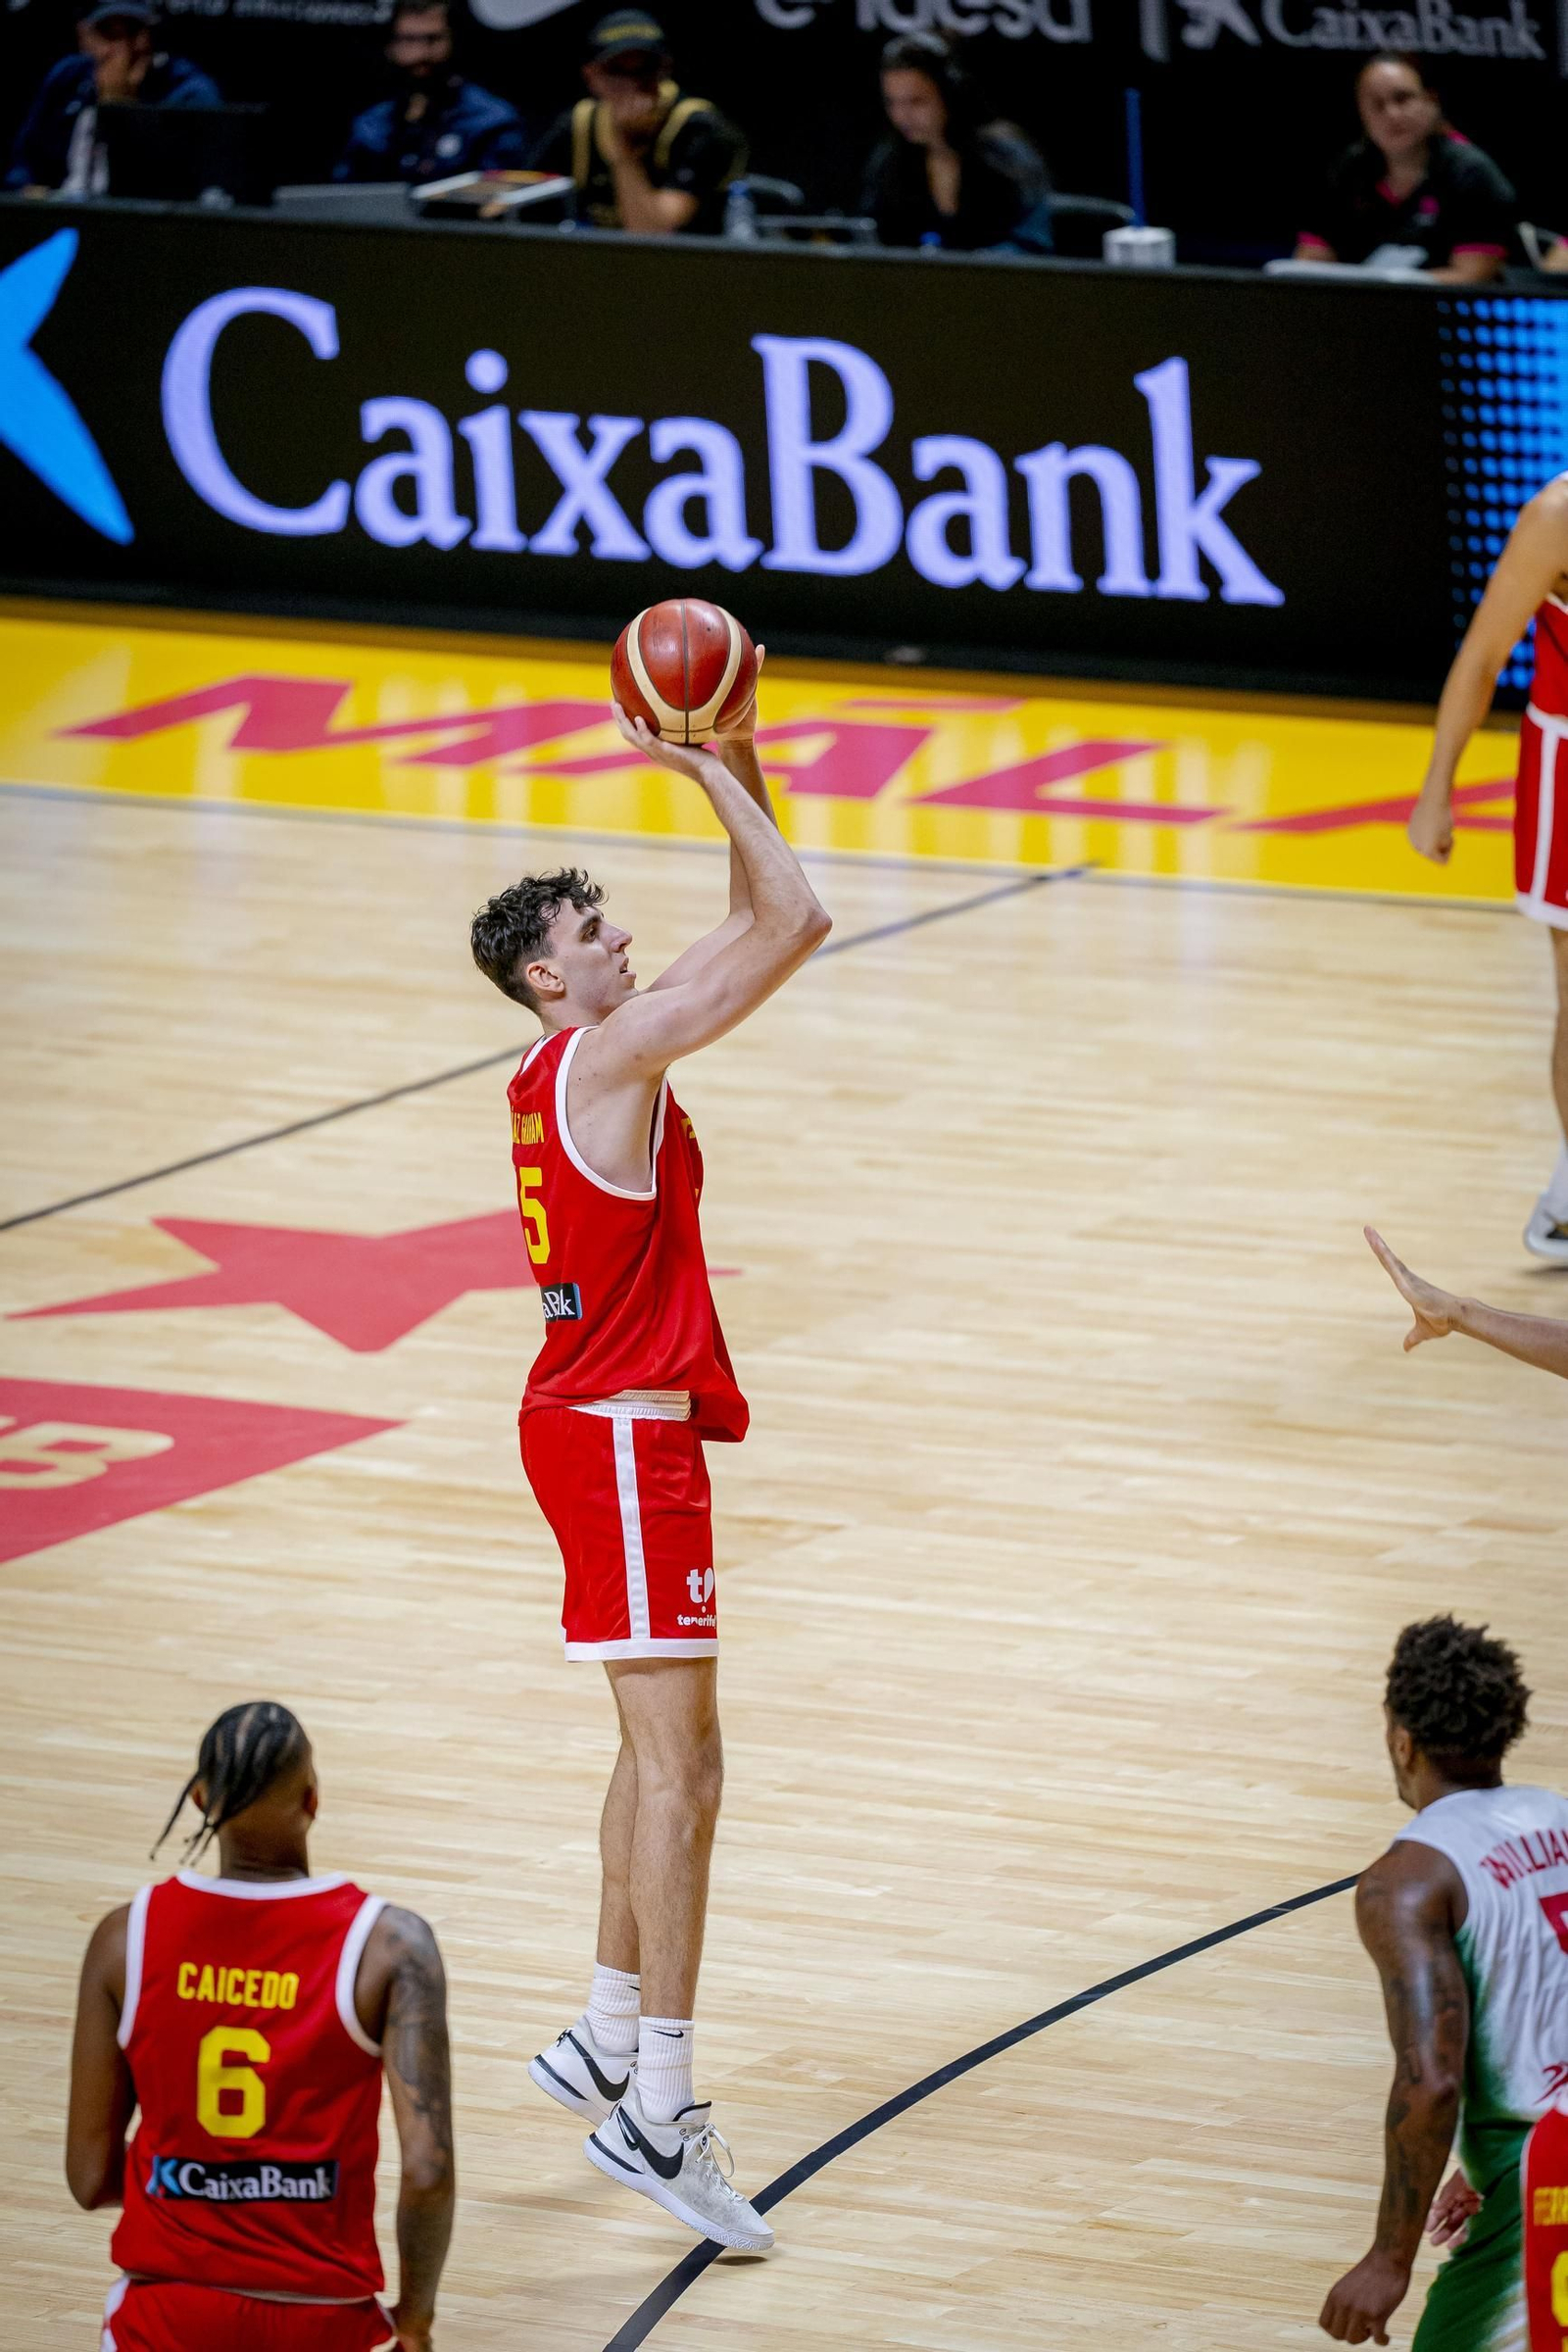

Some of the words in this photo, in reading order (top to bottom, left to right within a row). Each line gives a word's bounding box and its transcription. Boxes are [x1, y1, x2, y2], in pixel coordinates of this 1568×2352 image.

[160, 286, 1285, 607] CaixaBank
[177, 1962, 299, 2010] CAICEDO
[197, 2025, 271, 2139] 6
[178, 2162, 333, 2200] CaixaBank
